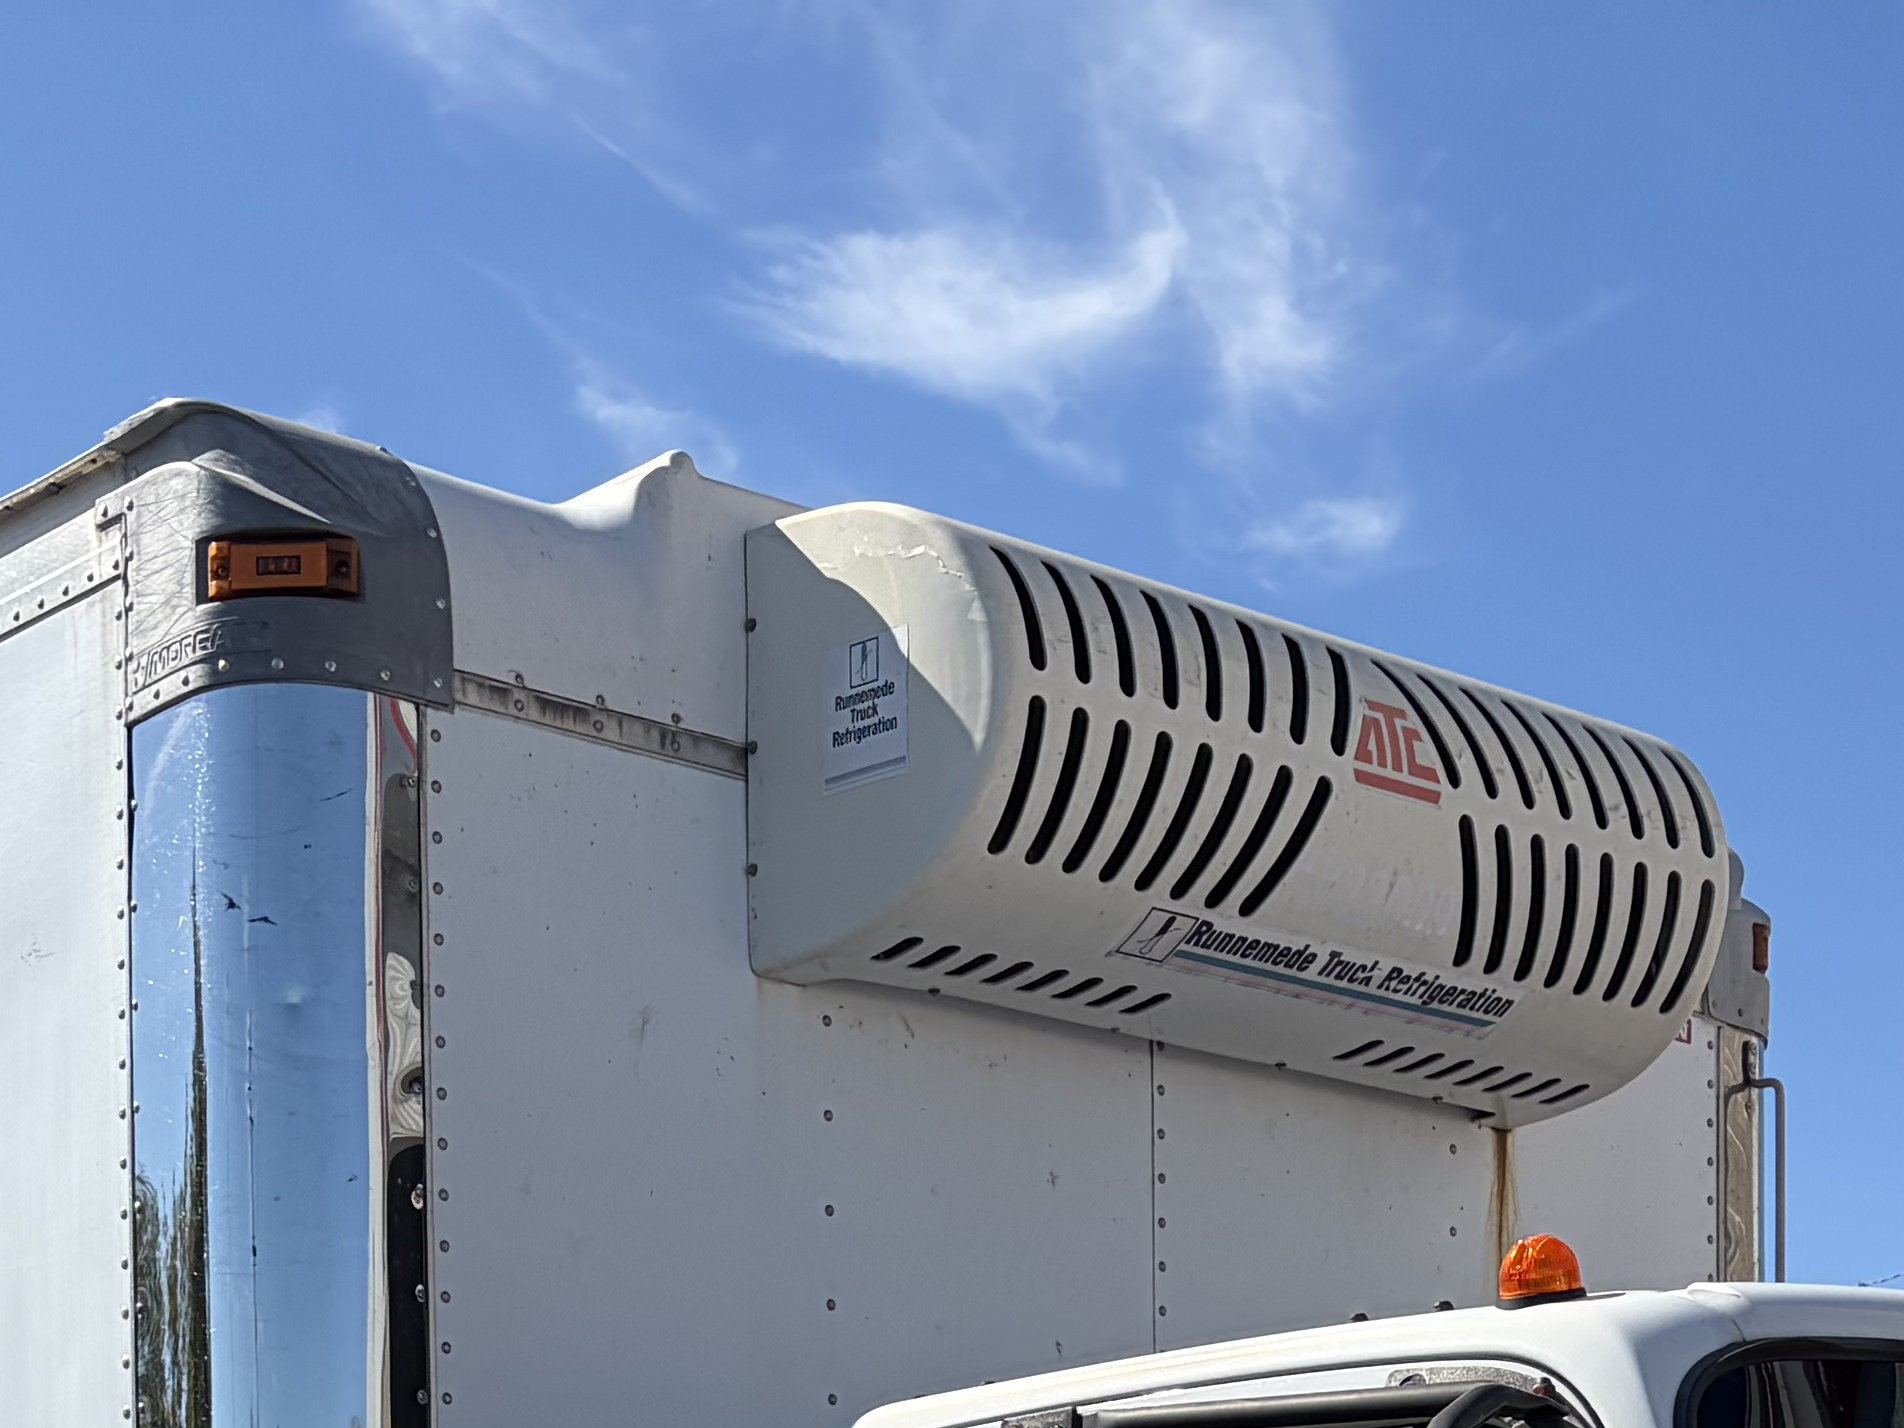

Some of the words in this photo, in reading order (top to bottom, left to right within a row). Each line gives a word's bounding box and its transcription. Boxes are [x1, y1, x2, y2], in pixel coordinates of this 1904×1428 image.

[834, 680, 895, 712] Runnemede
[850, 702, 879, 724] Truck
[832, 716, 898, 749] Refrigeration
[1353, 699, 1442, 785] ATC
[1185, 920, 1318, 972] Runnemede
[1318, 950, 1379, 988] Truck
[1377, 966, 1516, 1019] Refrigeration
